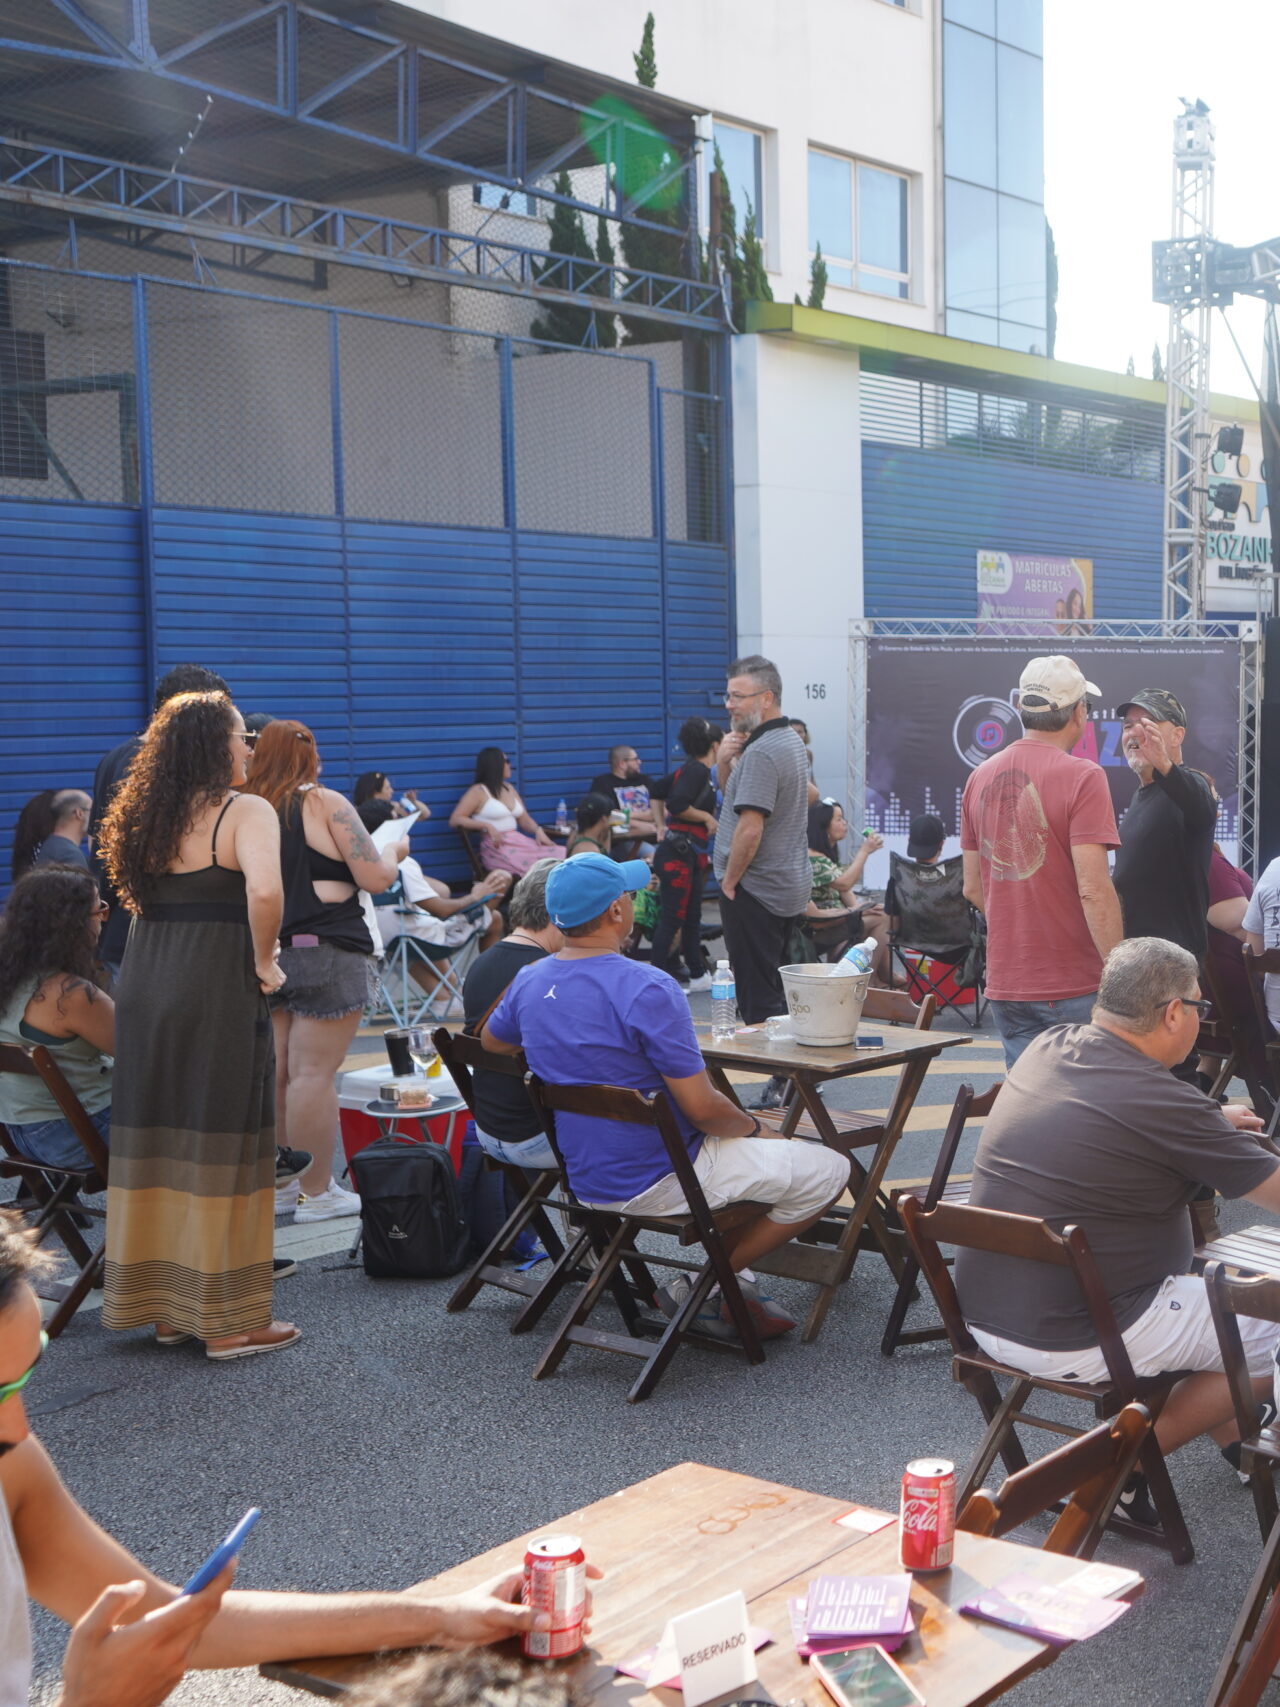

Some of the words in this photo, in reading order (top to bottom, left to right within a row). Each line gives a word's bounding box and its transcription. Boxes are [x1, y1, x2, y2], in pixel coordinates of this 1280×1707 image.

[1015, 559, 1072, 577] MATRÍCULAS
[1023, 578, 1064, 594] ABERTAS
[804, 683, 826, 700] 156
[681, 1632, 747, 1670] RESERVADO
